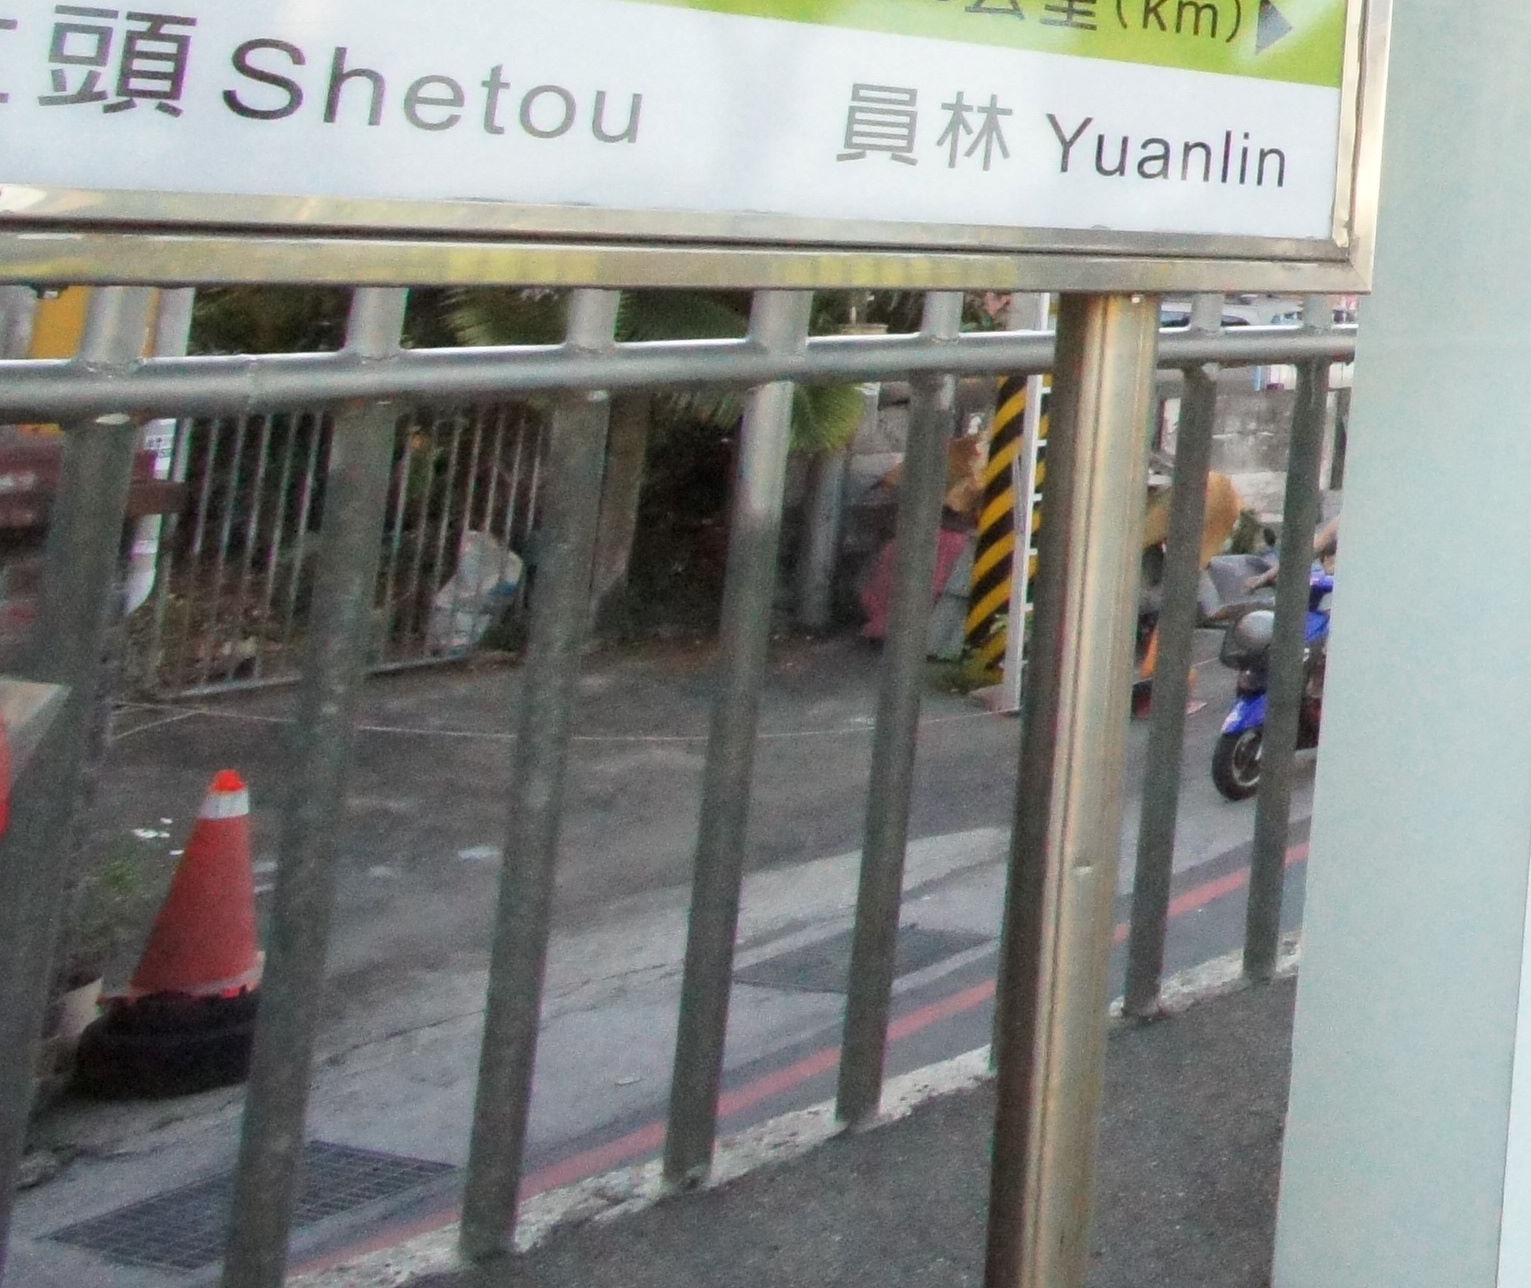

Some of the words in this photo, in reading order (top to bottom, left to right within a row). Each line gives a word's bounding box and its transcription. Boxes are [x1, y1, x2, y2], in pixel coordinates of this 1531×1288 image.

[0, 5, 197, 118] 頭
[222, 38, 643, 144] Shetou
[836, 83, 1013, 172] 員林
[1046, 112, 1287, 188] Yuanlin
